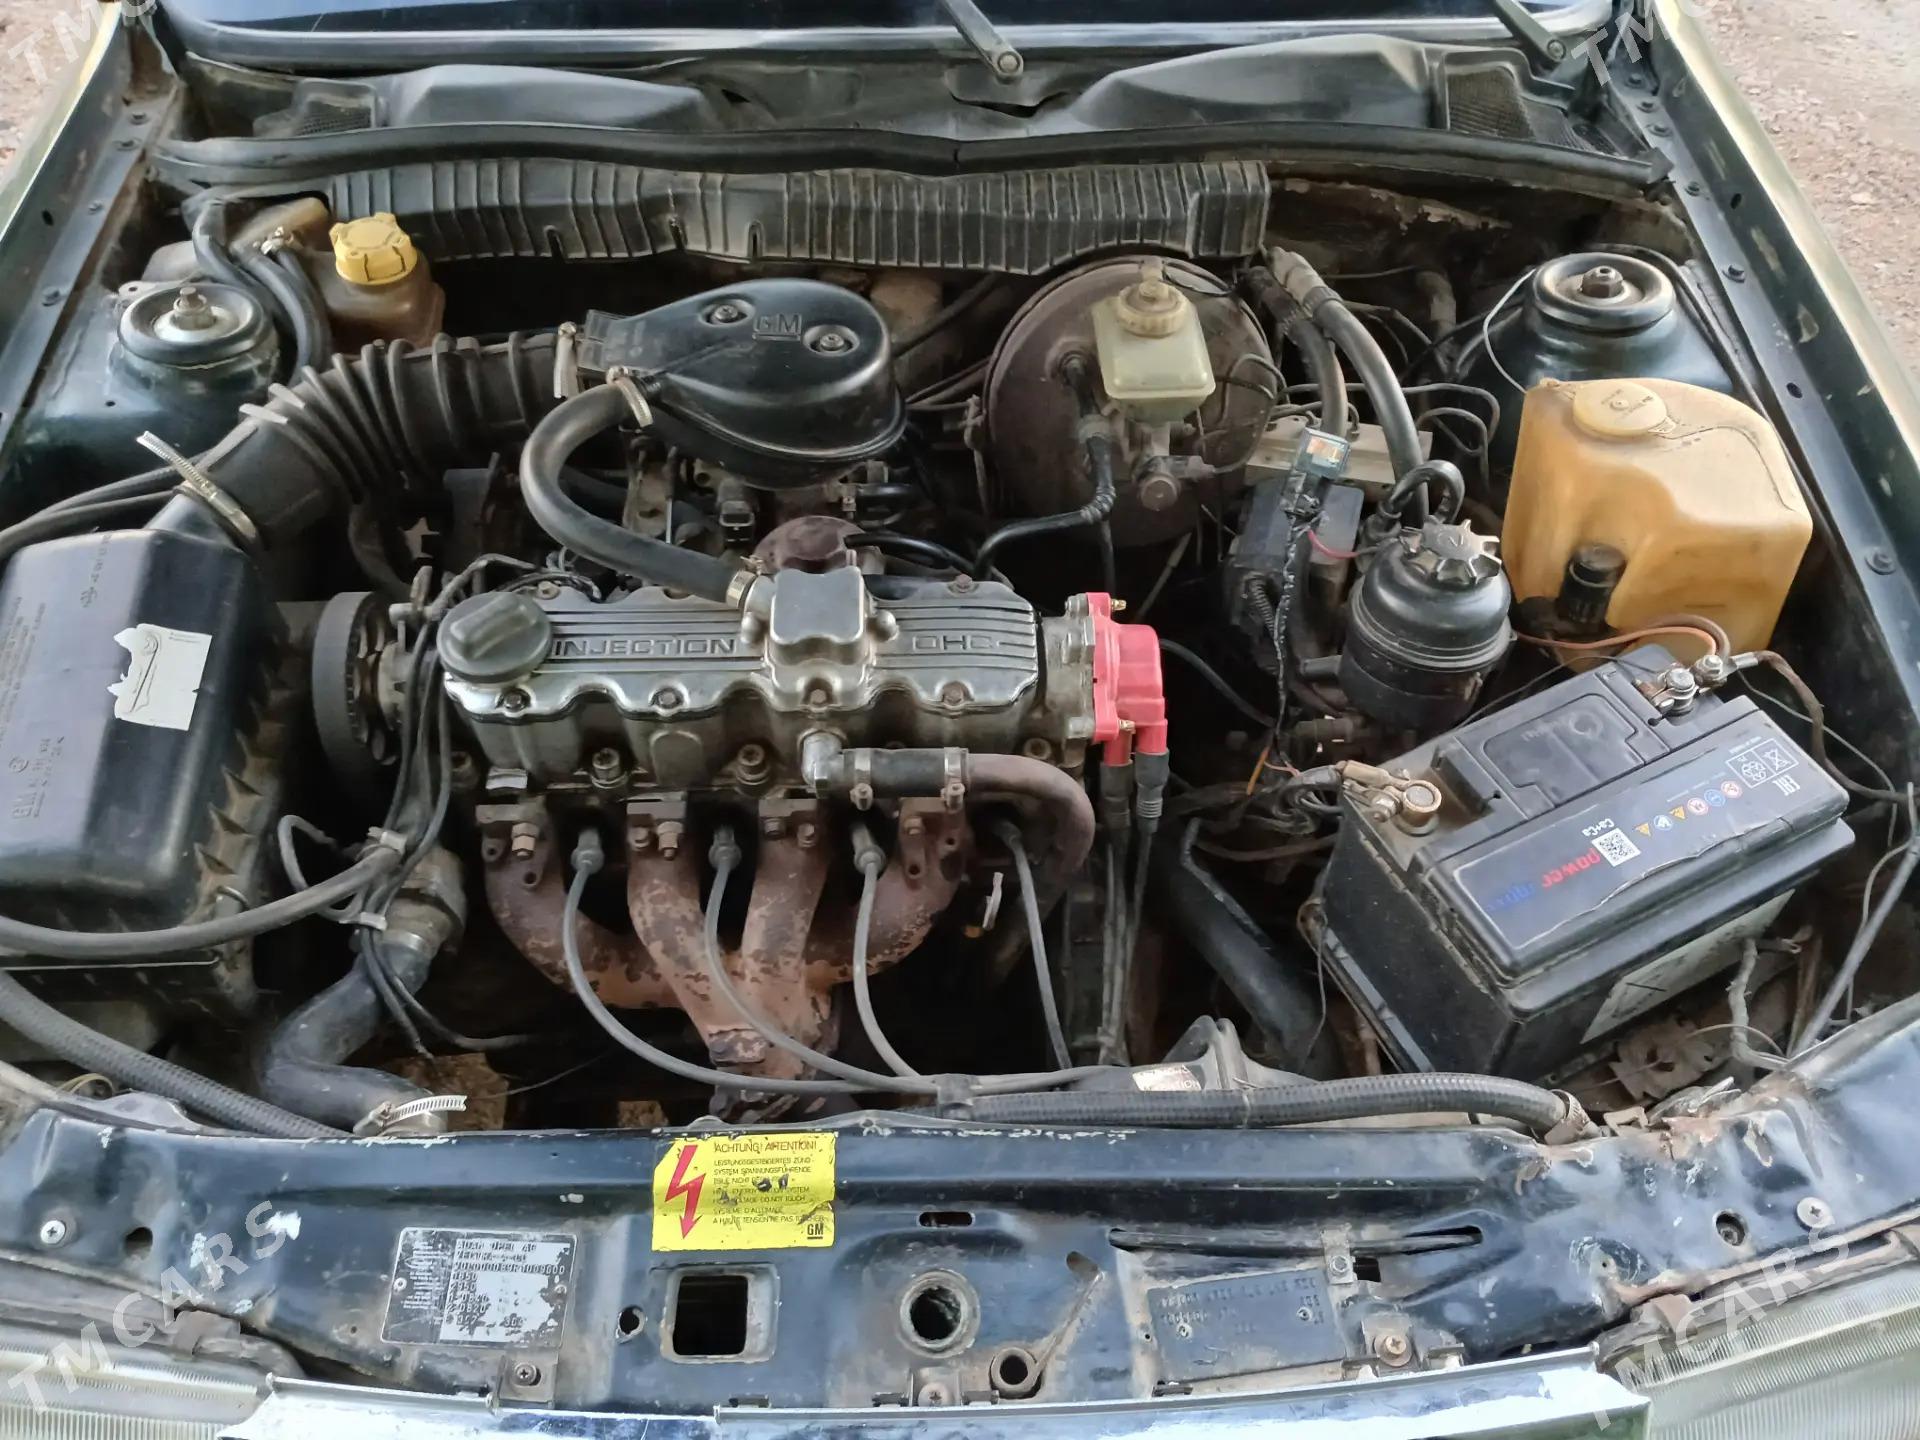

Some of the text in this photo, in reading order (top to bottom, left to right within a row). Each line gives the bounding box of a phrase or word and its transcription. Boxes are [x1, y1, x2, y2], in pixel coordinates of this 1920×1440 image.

[753, 313, 802, 334] GM
[552, 638, 738, 656] INJECTION
[1582, 818, 1615, 837] Ca+Ca
[807, 1223, 824, 1235] GM
